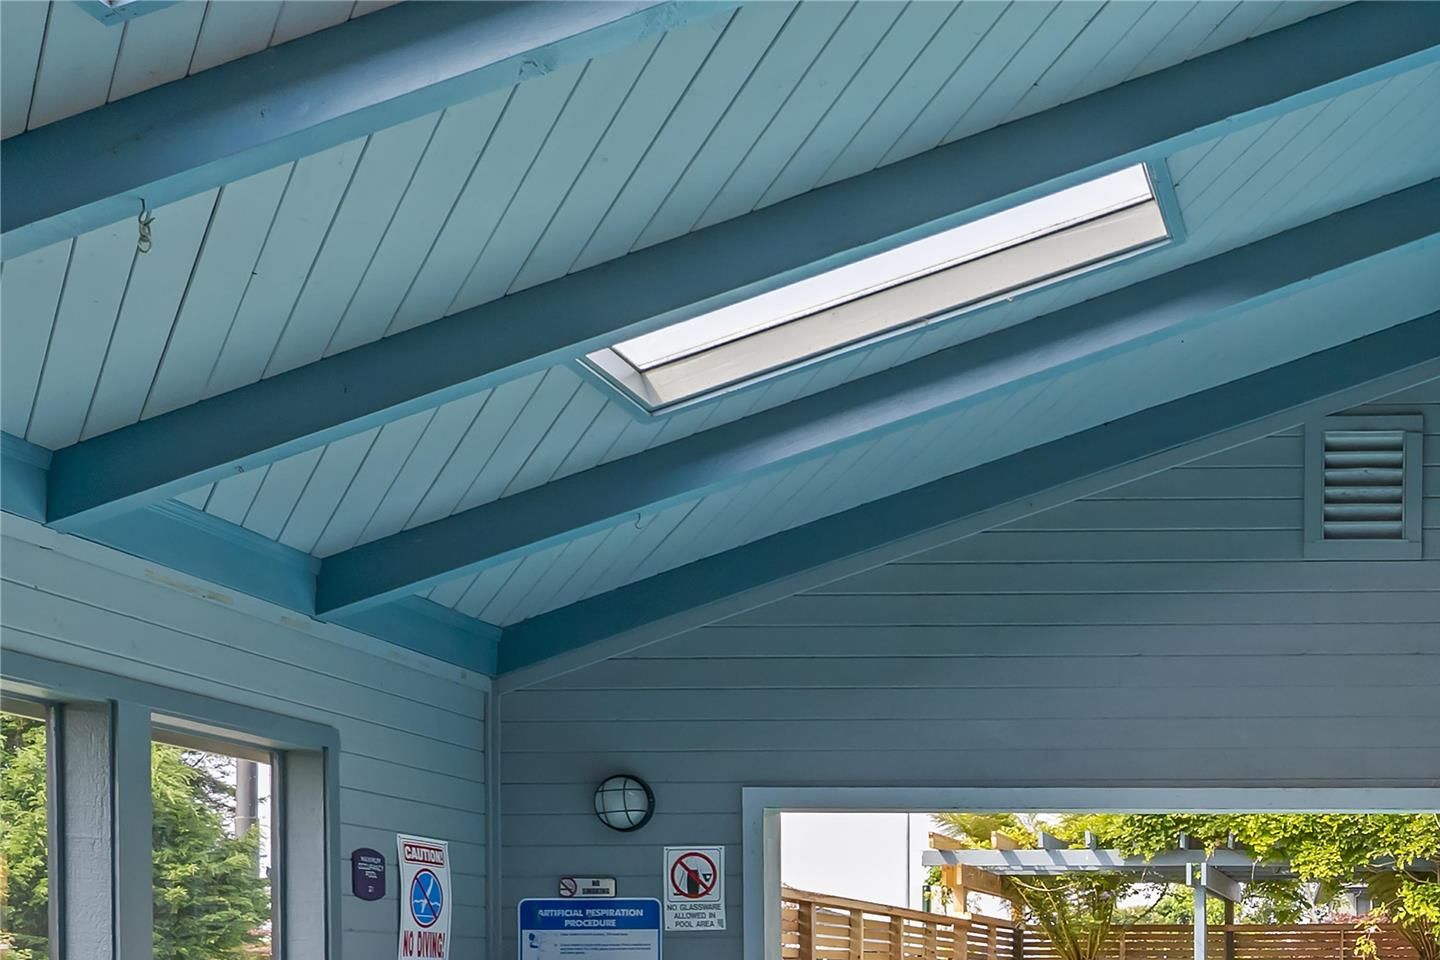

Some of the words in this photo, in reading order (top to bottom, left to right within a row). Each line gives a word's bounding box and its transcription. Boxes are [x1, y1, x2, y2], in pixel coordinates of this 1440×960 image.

[404, 846, 445, 864] CAUTION!
[538, 909, 583, 917] ARTIFICIAL
[586, 909, 643, 917] RESPIRATION
[564, 919, 616, 927] PROCEDURE
[696, 920, 715, 928] AREA
[403, 931, 413, 957] NO
[417, 931, 445, 958] DIVING!
